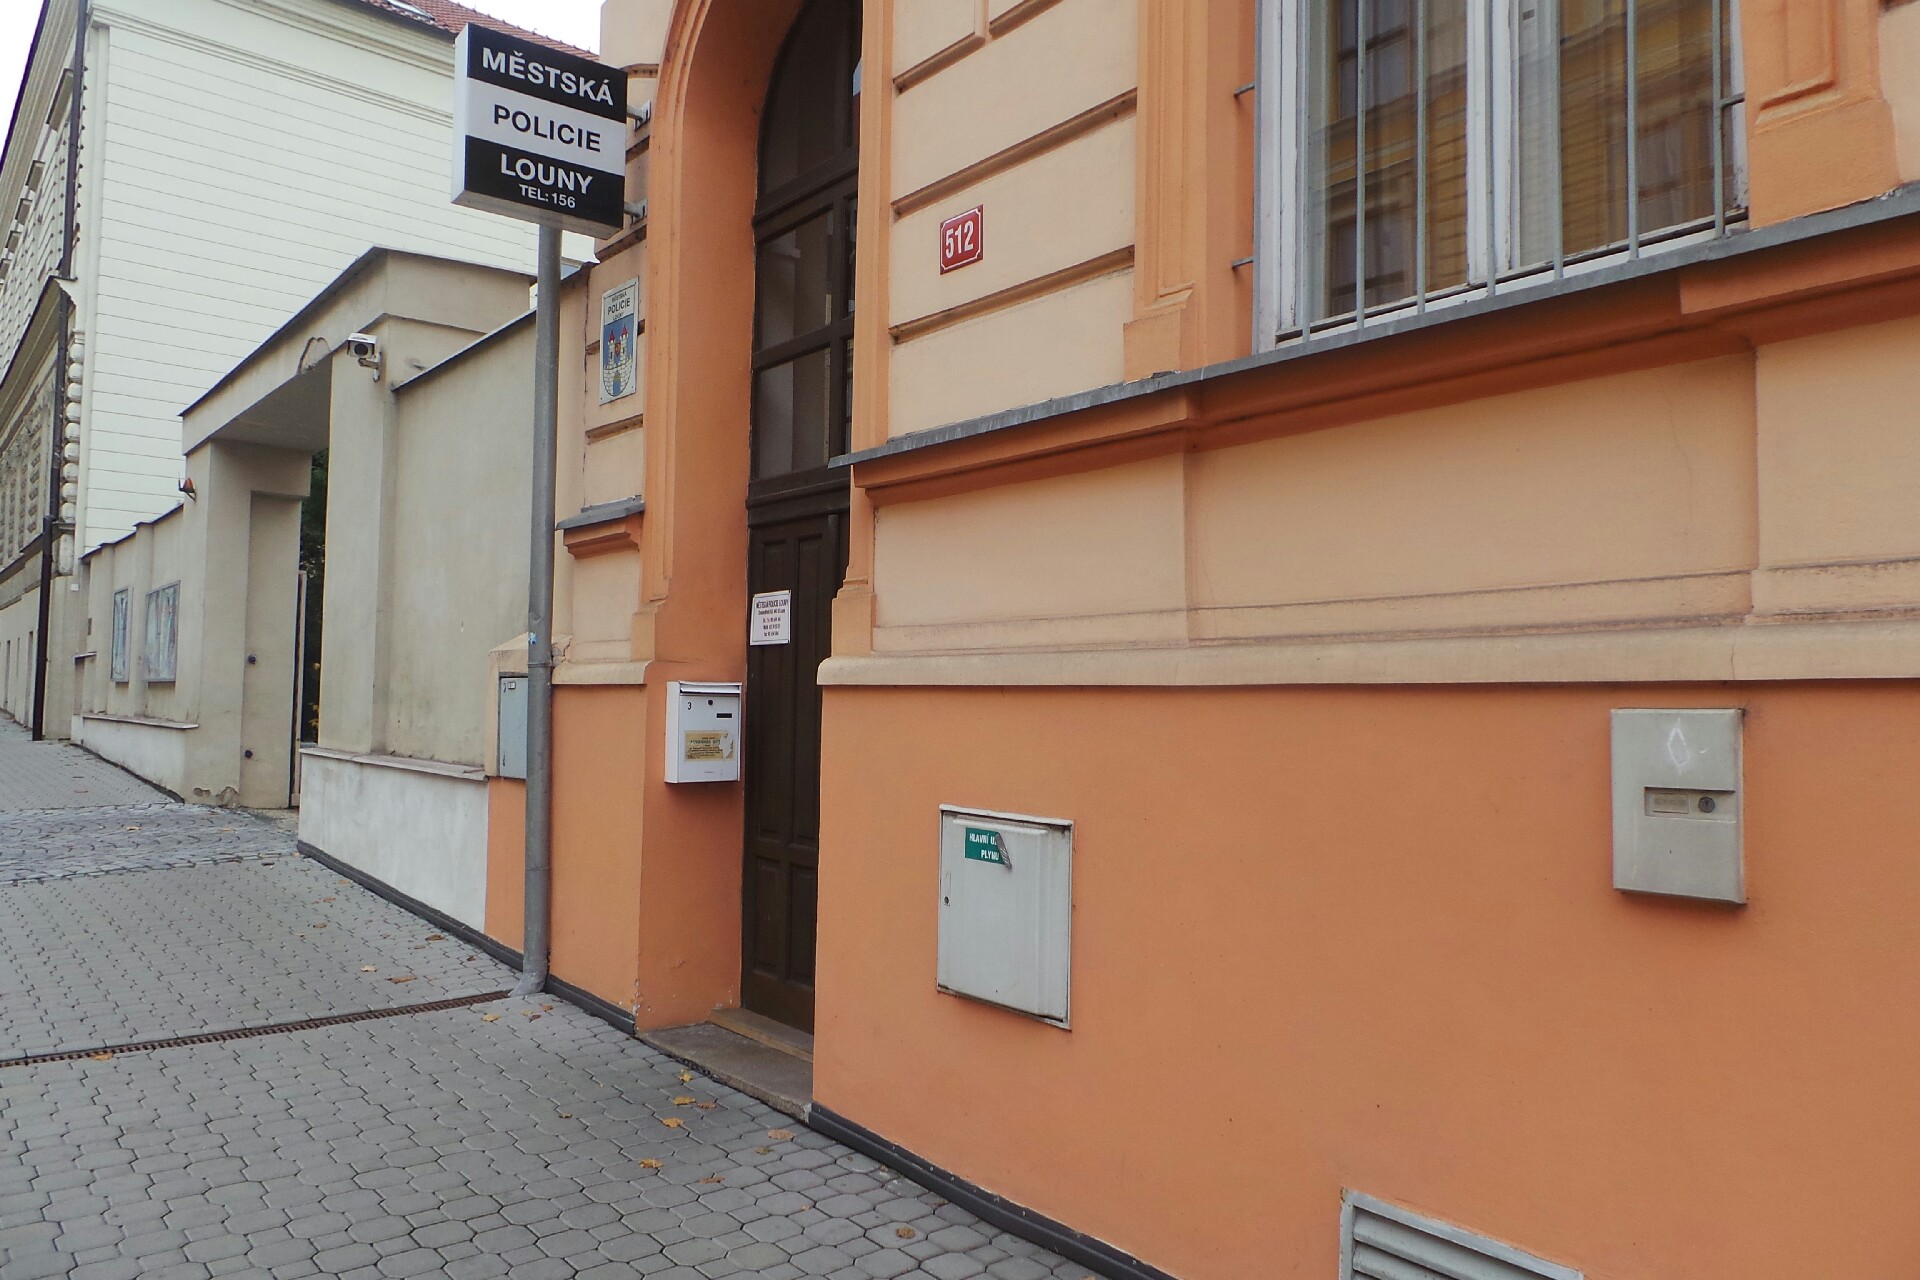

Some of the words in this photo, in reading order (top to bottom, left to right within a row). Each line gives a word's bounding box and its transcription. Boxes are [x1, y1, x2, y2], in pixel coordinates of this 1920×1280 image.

[482, 47, 614, 106] MĚSTSKÁ
[494, 104, 601, 153] POLICIE
[501, 152, 593, 195] LOUNY
[551, 192, 576, 209] 156
[945, 220, 974, 259] 512
[607, 297, 631, 315] POLICIE
[687, 701, 692, 710] 3
[969, 832, 990, 845] HLAVNÍ
